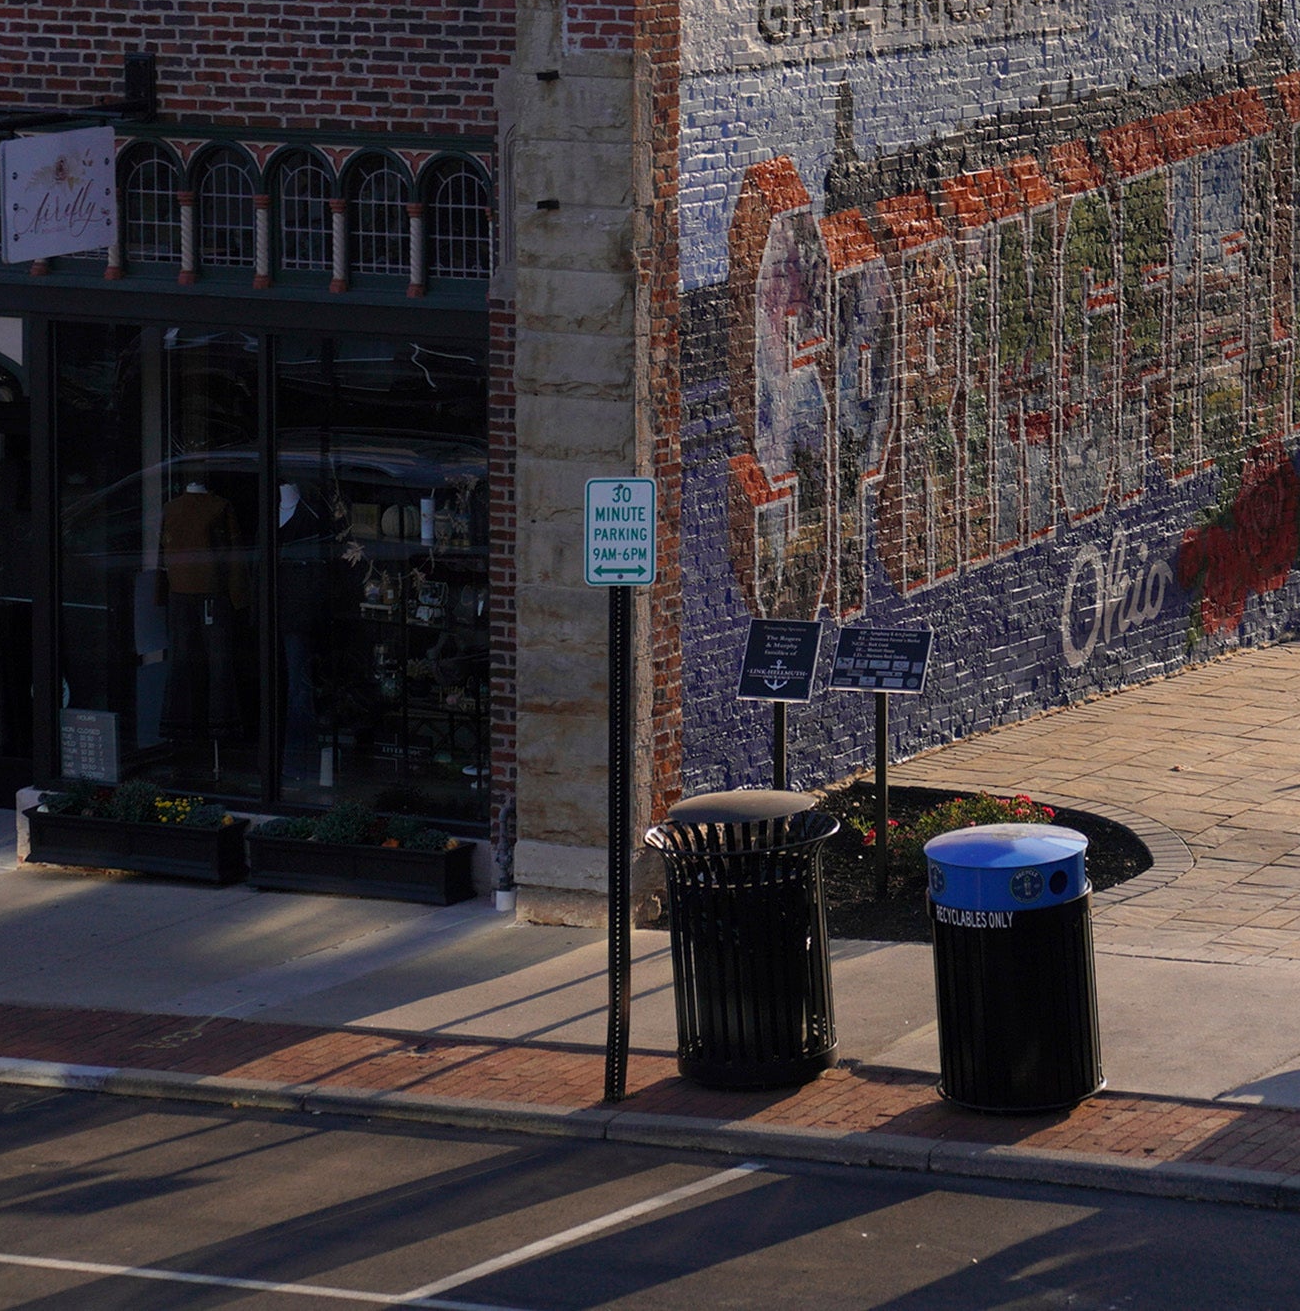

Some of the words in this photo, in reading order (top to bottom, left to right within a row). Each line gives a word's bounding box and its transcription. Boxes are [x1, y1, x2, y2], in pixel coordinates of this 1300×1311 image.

[611, 486, 632, 503] 30
[595, 506, 646, 522] MINUTE
[593, 527, 648, 541] PARKING
[592, 547, 647, 561] 9AM-6PM
[1061, 525, 1173, 668] Ohio
[935, 904, 987, 929] RECYCLABLES
[987, 911, 1014, 930] ONLY
